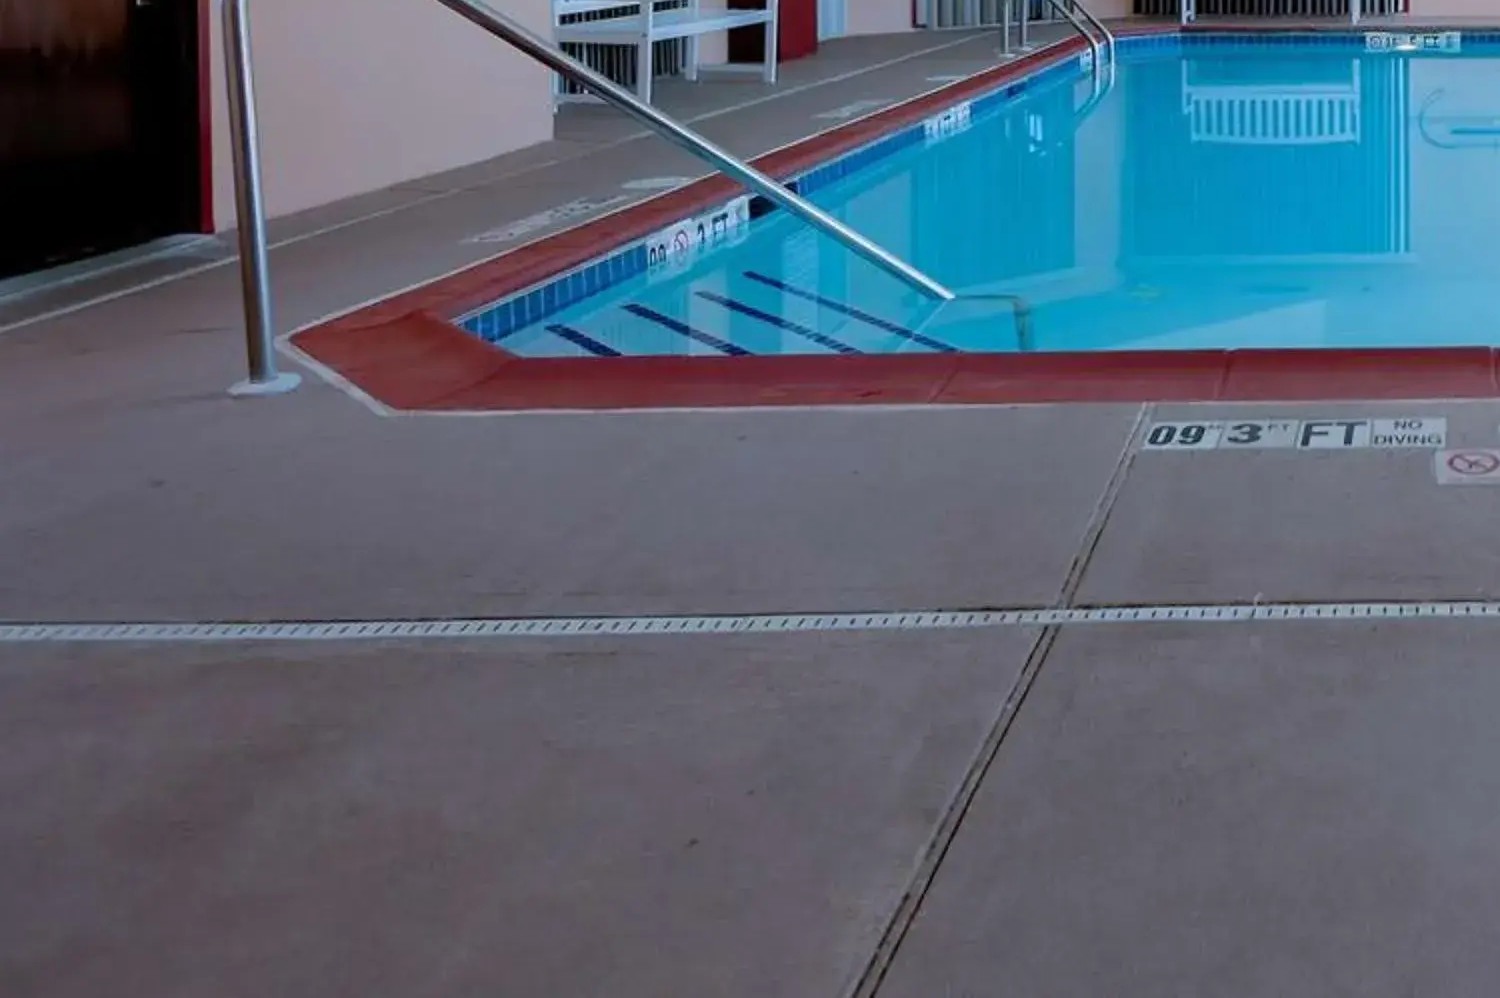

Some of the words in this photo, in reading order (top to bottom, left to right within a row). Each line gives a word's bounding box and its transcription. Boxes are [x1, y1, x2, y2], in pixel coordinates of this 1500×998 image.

[1393, 419, 1424, 430] NO
[1148, 425, 1205, 445] 09
[1227, 423, 1262, 443] 3
[1300, 420, 1368, 447] FT
[1374, 433, 1442, 445] DIVING
